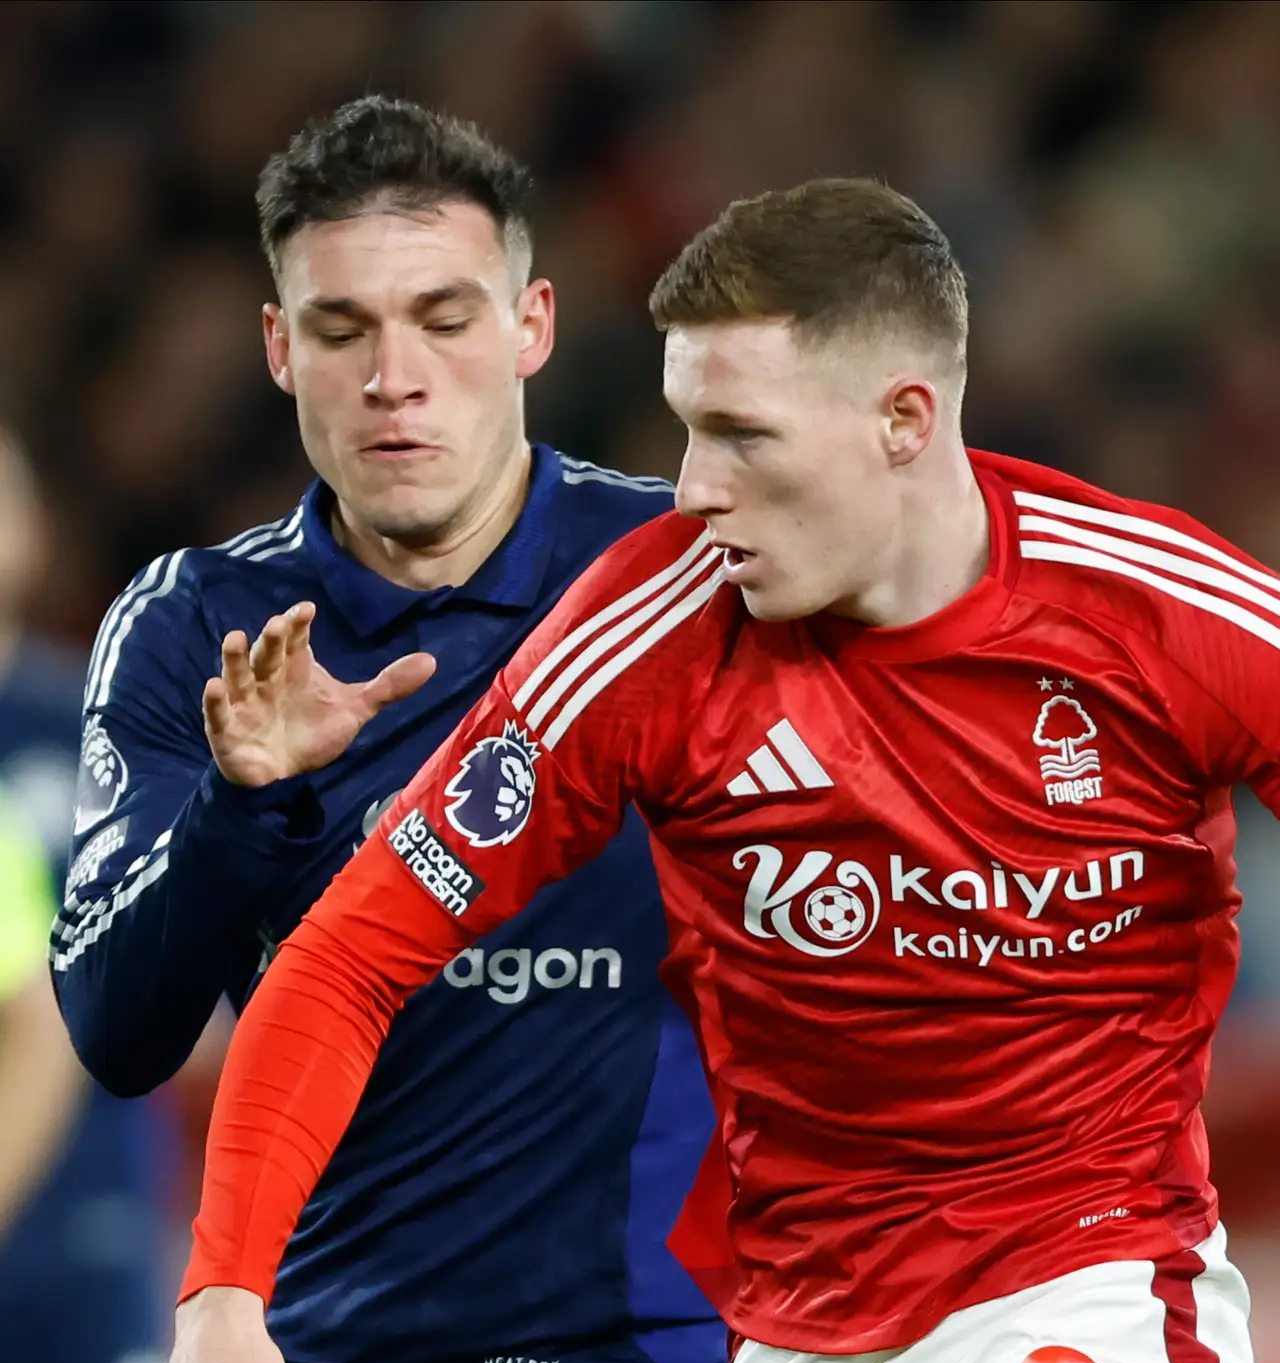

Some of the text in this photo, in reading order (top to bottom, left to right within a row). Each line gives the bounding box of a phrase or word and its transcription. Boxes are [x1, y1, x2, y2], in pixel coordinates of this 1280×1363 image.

[388, 825, 468, 916] for racism
[402, 808, 473, 894] No room
[890, 850, 1145, 919] kaiyun
[894, 904, 1144, 967] kaiyun.com
[443, 947, 622, 1005] agon
